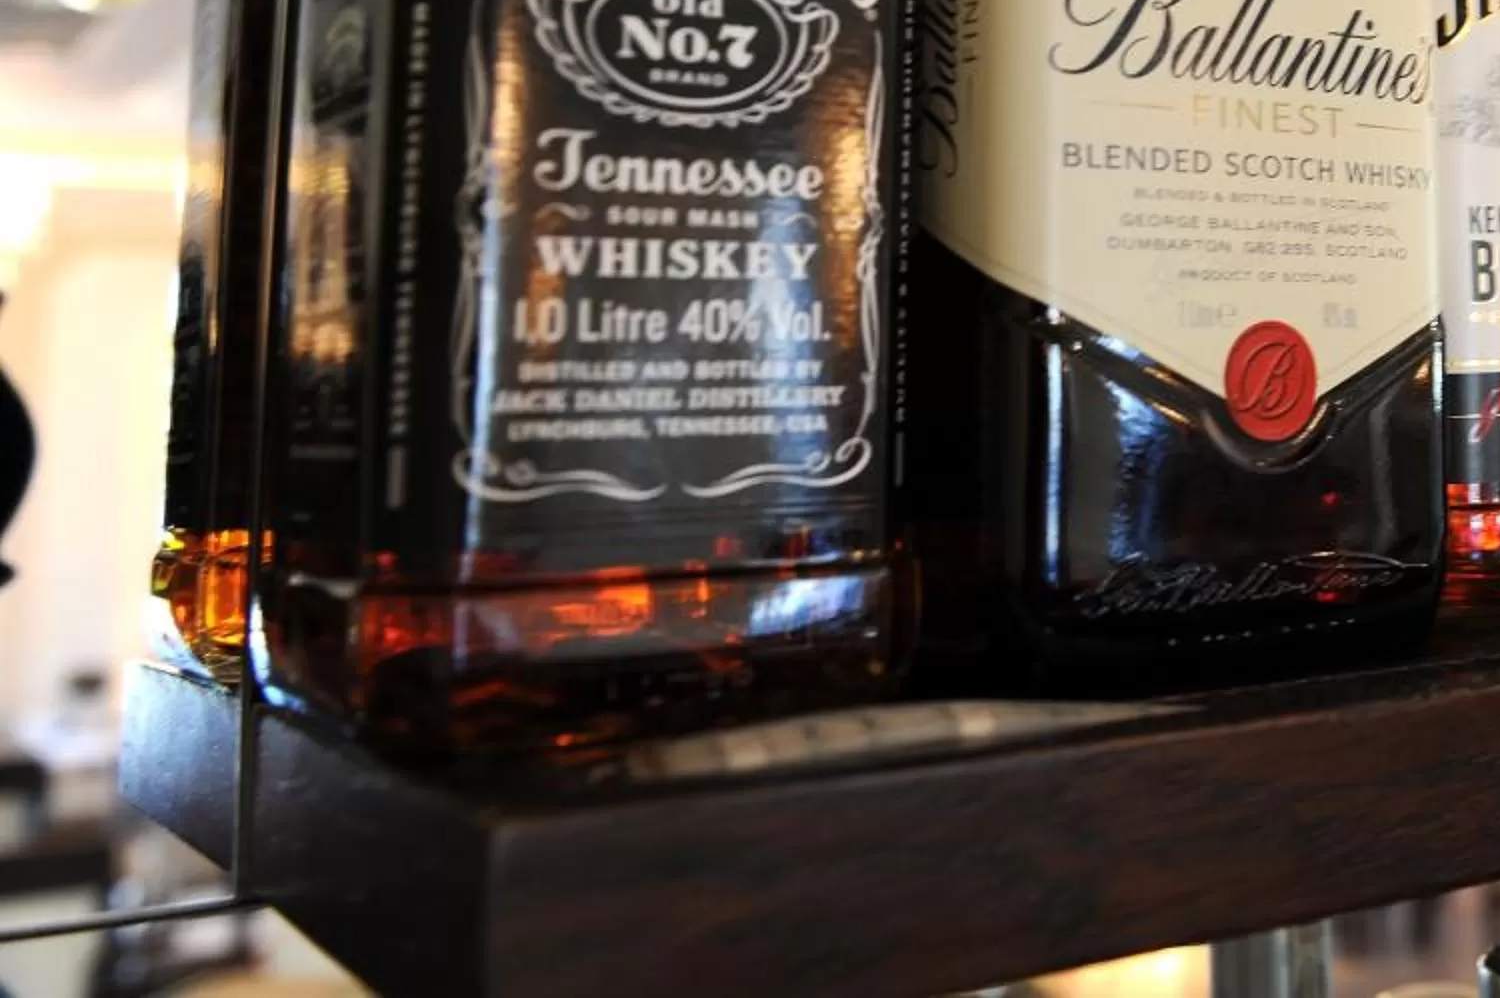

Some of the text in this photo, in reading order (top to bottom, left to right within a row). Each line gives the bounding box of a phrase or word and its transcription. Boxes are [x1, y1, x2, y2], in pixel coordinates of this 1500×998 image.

[615, 15, 758, 70] No.7
[648, 67, 729, 88] BRAND
[1191, 94, 1344, 139] FINEST
[533, 128, 824, 199] Tennessee
[1063, 141, 1432, 191] BLENDED SCOTCH WHISKY
[606, 206, 759, 229] SOUR MASH
[1120, 212, 1200, 230] GEORGE
[1208, 216, 1321, 236] BALLANTINE
[536, 235, 818, 281] WHISKEY
[577, 298, 668, 344] Litre
[677, 297, 759, 344] 40%
[518, 359, 637, 384] DISTILLED
[641, 359, 691, 382] AND
